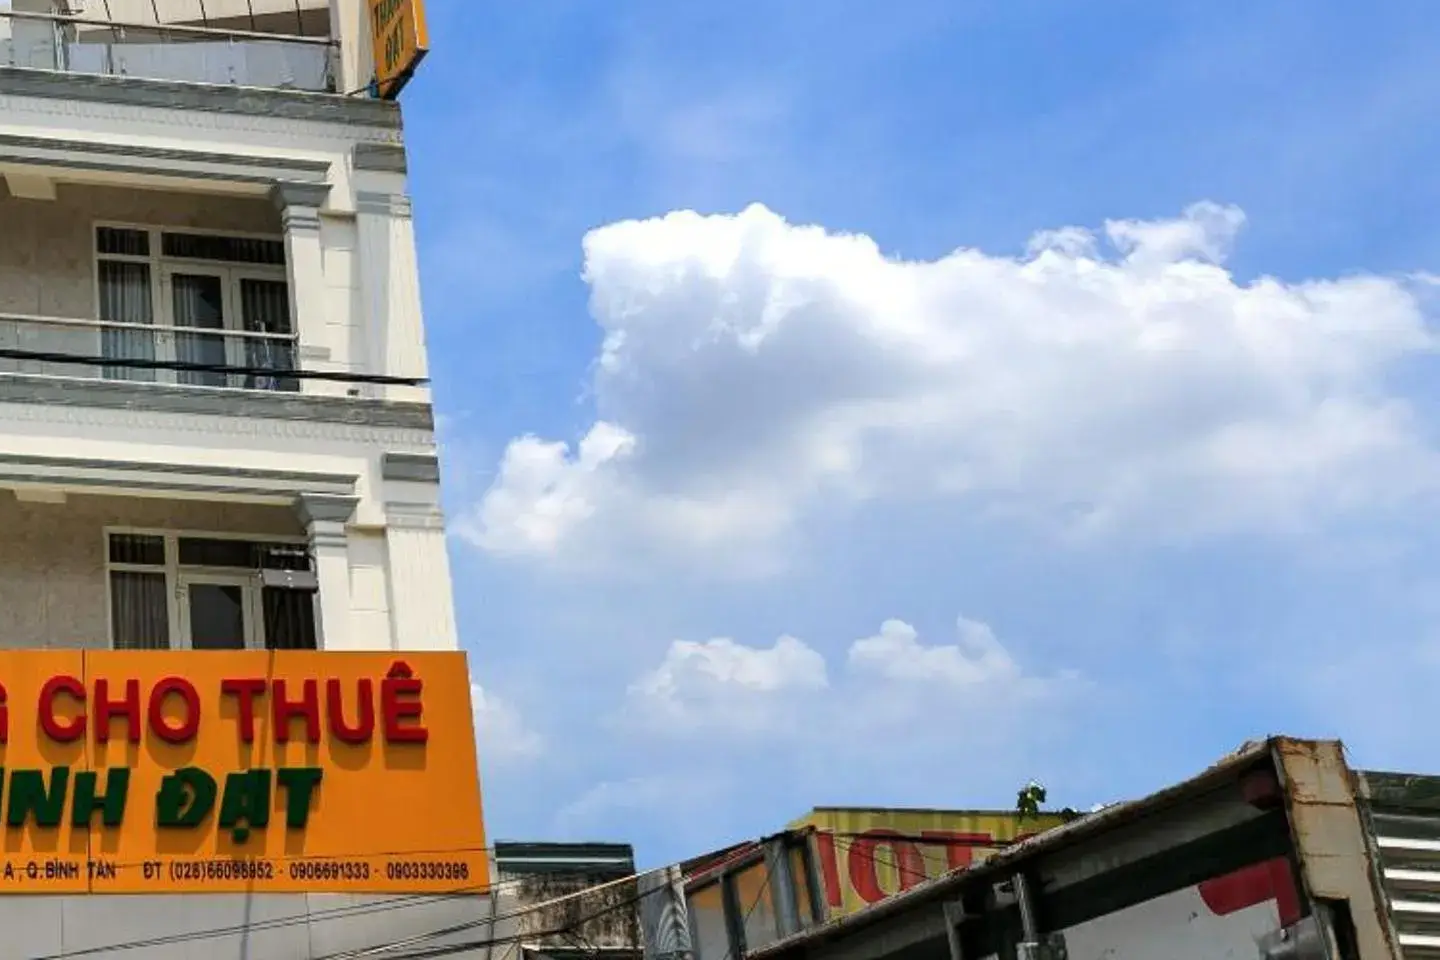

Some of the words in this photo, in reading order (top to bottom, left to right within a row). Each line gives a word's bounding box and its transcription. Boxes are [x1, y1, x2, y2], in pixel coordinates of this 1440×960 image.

[38, 674, 202, 744] CHO
[220, 660, 429, 745] THUÊ
[155, 766, 324, 844] ĐẠT
